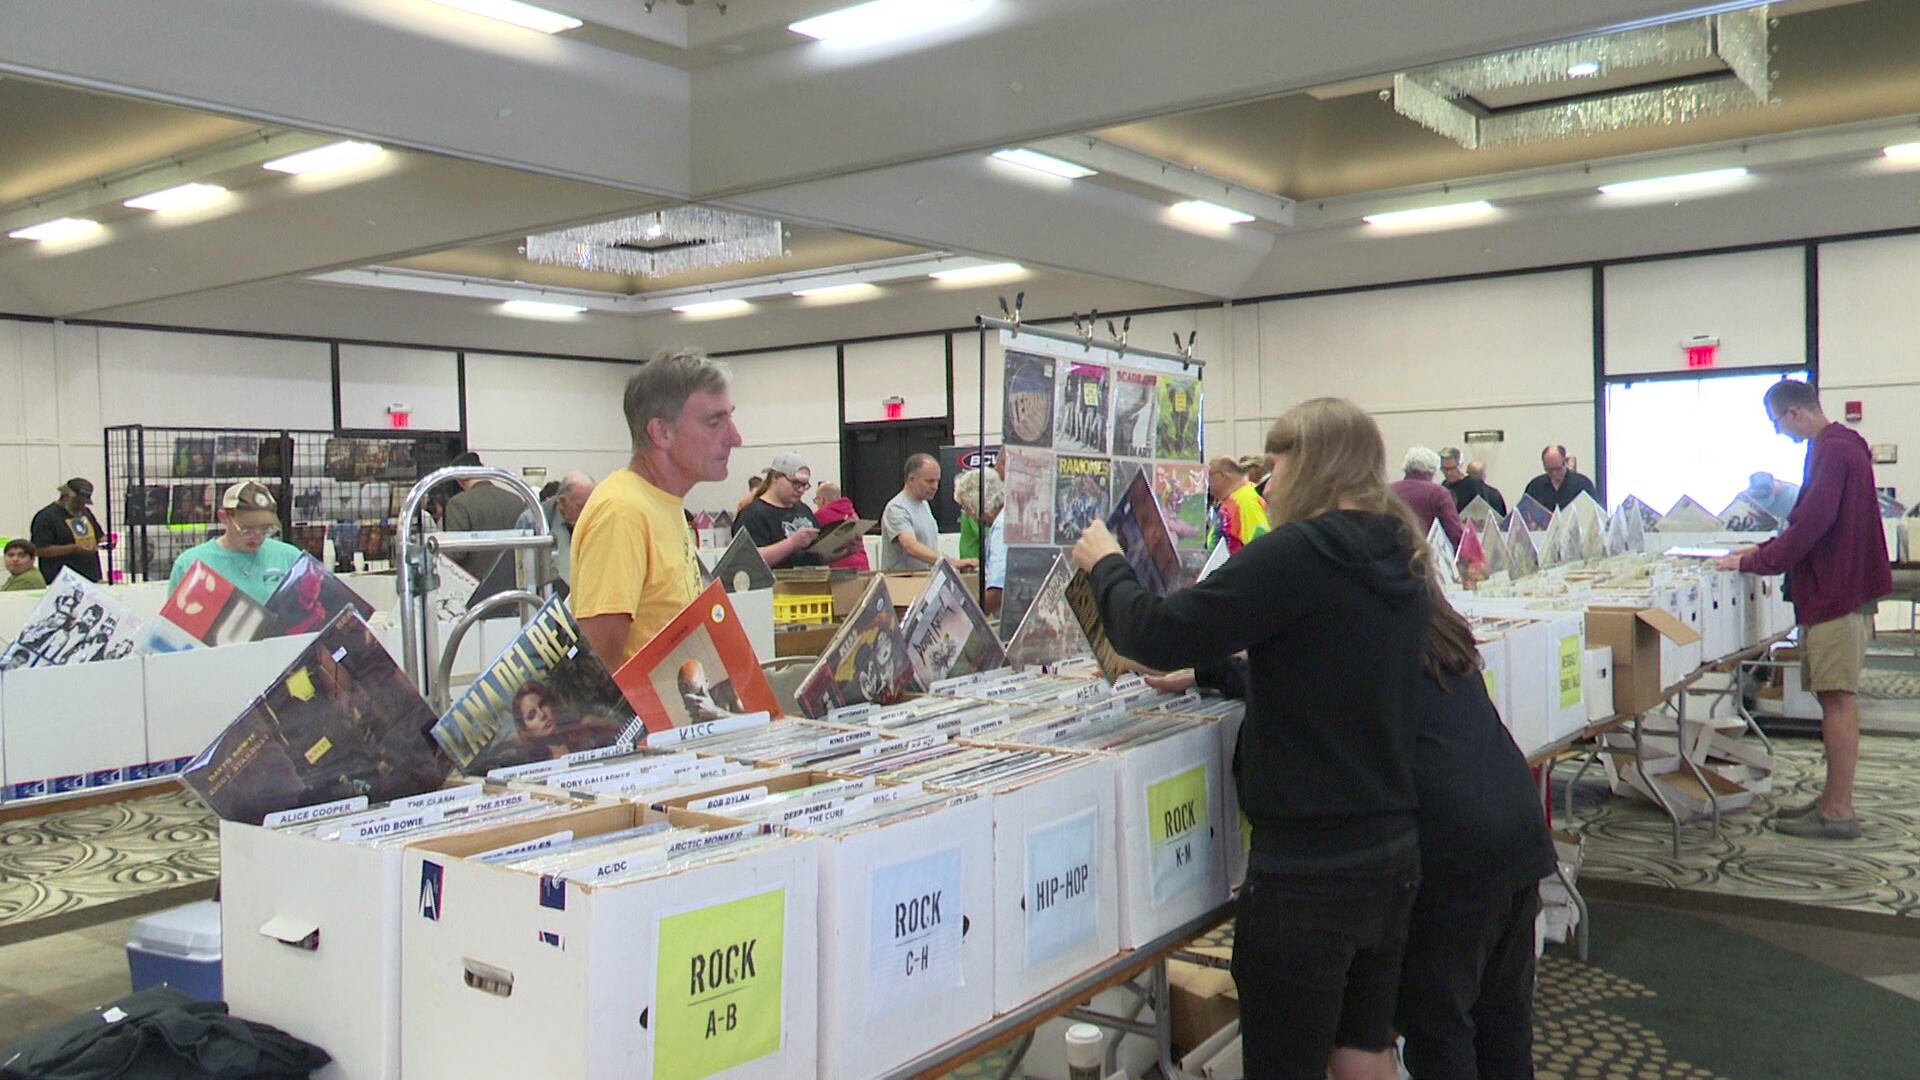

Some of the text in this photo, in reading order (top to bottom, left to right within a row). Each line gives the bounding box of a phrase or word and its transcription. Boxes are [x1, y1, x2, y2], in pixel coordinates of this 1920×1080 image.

[970, 452, 997, 466] BC
[1059, 458, 1109, 475] RAMONES
[437, 598, 578, 769] LANA DEL REY
[560, 779, 583, 789] RORY
[408, 799, 424, 809] THE
[476, 803, 494, 812] THE
[707, 793, 751, 809] BOB DYLAN
[784, 801, 833, 821] DEEP PURPLE
[280, 803, 352, 825] ALICE COOPER
[809, 808, 844, 825] THE CURE
[1165, 799, 1196, 838] ROCK
[360, 822, 391, 837] DAVID
[393, 817, 424, 831] BOWIE
[1176, 842, 1192, 868] K-M
[597, 860, 628, 877] AC/DC
[1036, 864, 1088, 912] HIP-HOP
[895, 890, 941, 938] ROCK
[691, 939, 756, 995] ROCK
[906, 945, 928, 976] C-H
[705, 1002, 737, 1039] A-B
